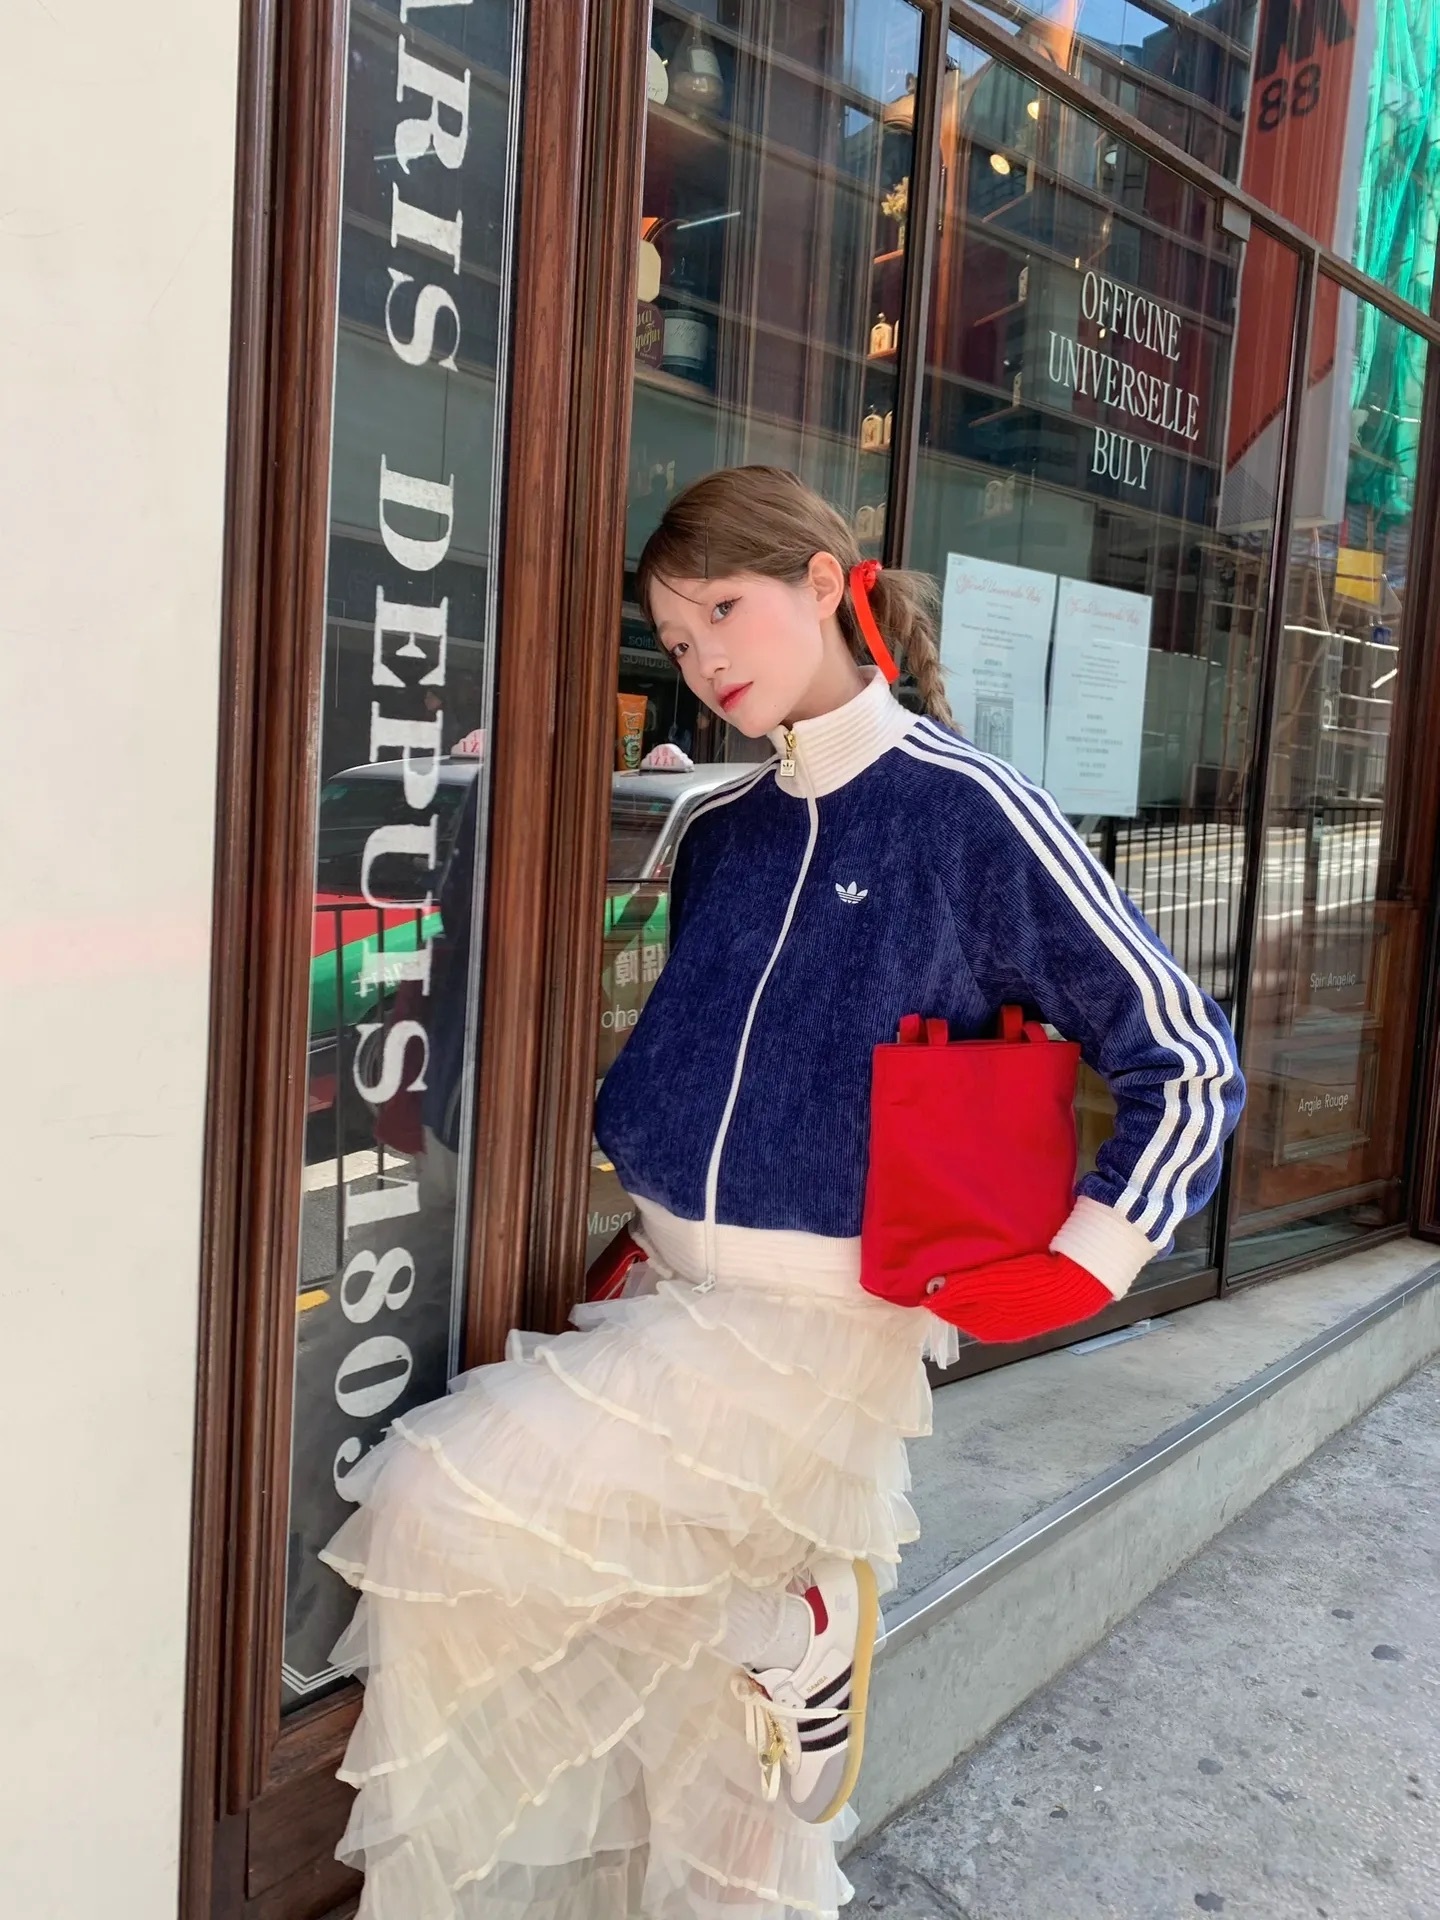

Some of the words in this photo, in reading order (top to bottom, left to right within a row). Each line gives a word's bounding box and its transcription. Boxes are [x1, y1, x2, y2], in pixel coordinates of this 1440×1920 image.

[1257, 63, 1321, 132] 88
[1082, 271, 1181, 361] OFFICINE
[1049, 331, 1200, 440] UNIVERSELLE
[1091, 426, 1152, 490] BULY
[354, 454, 454, 1103] DEPUIS
[1298, 1096, 1321, 1117] Argile
[1325, 1093, 1349, 1111] Rouge
